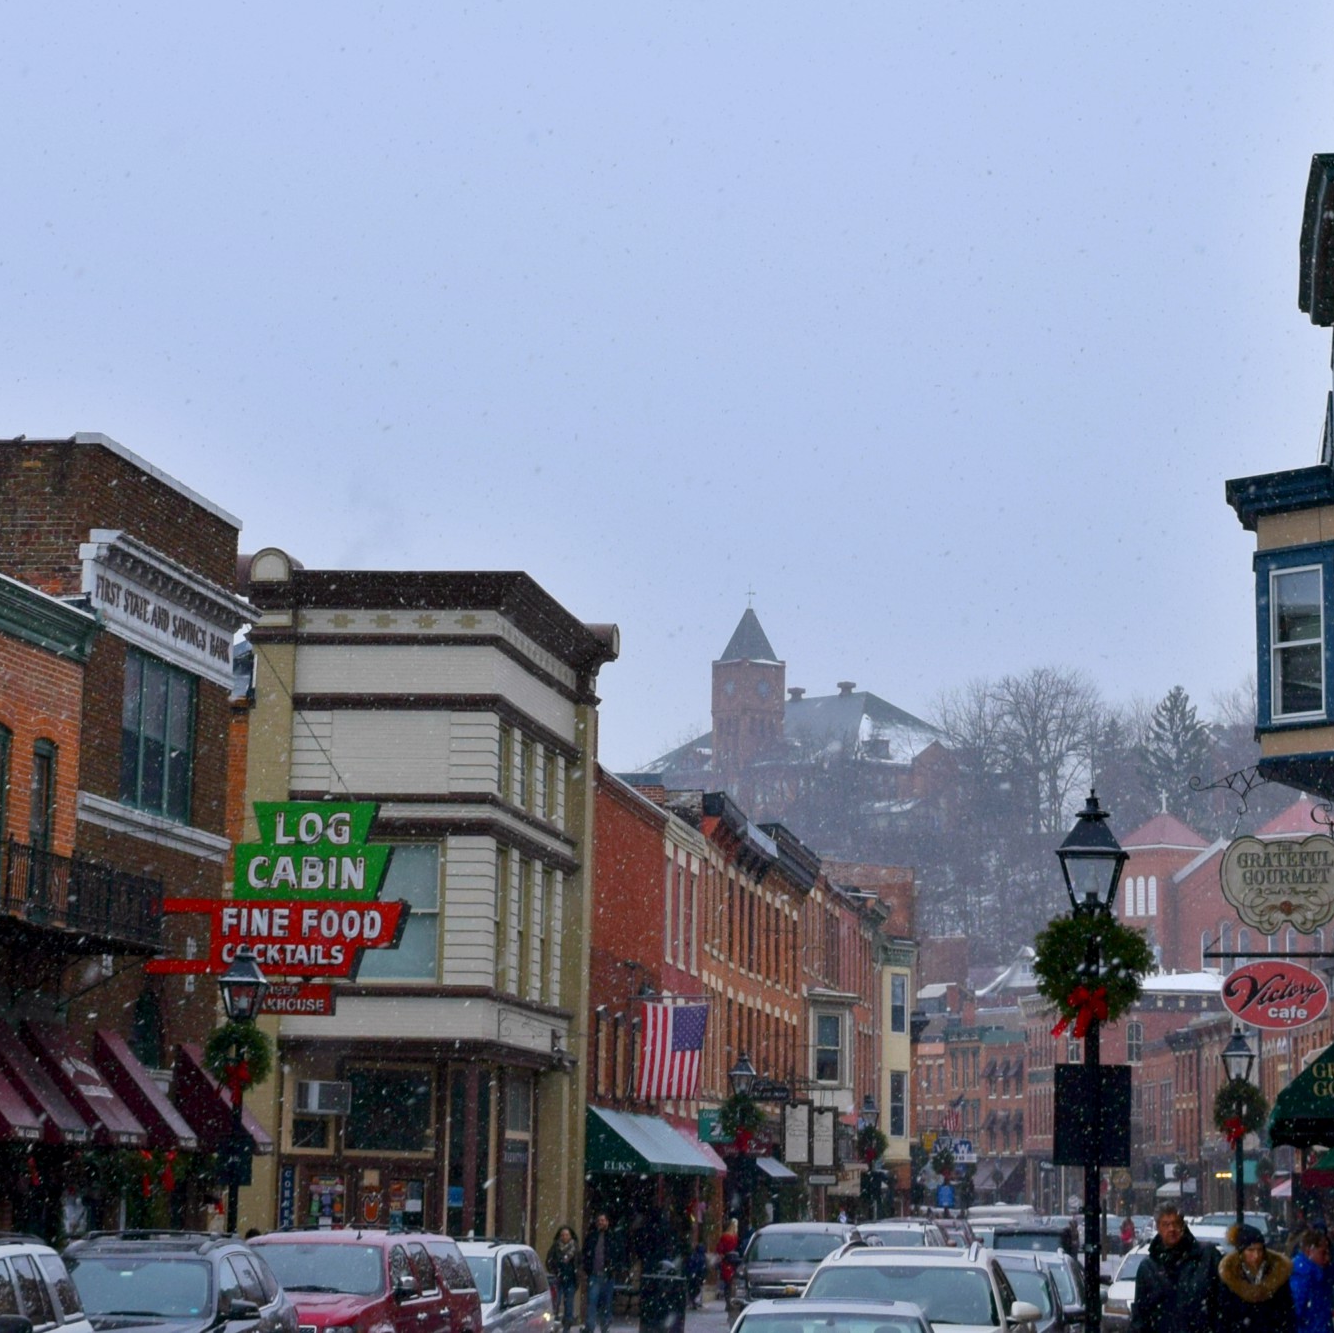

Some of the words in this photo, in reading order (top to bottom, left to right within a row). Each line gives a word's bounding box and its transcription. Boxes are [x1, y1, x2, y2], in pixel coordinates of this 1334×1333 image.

[275, 811, 352, 845] LOG
[247, 855, 365, 890] CABIN
[1236, 851, 1334, 868] GRATEFUL
[1242, 868, 1330, 886] GOURMET
[221, 907, 290, 937] FINE
[301, 908, 382, 939] FOOD
[1224, 972, 1325, 1014] Victory
[1267, 1005, 1308, 1019] cafe
